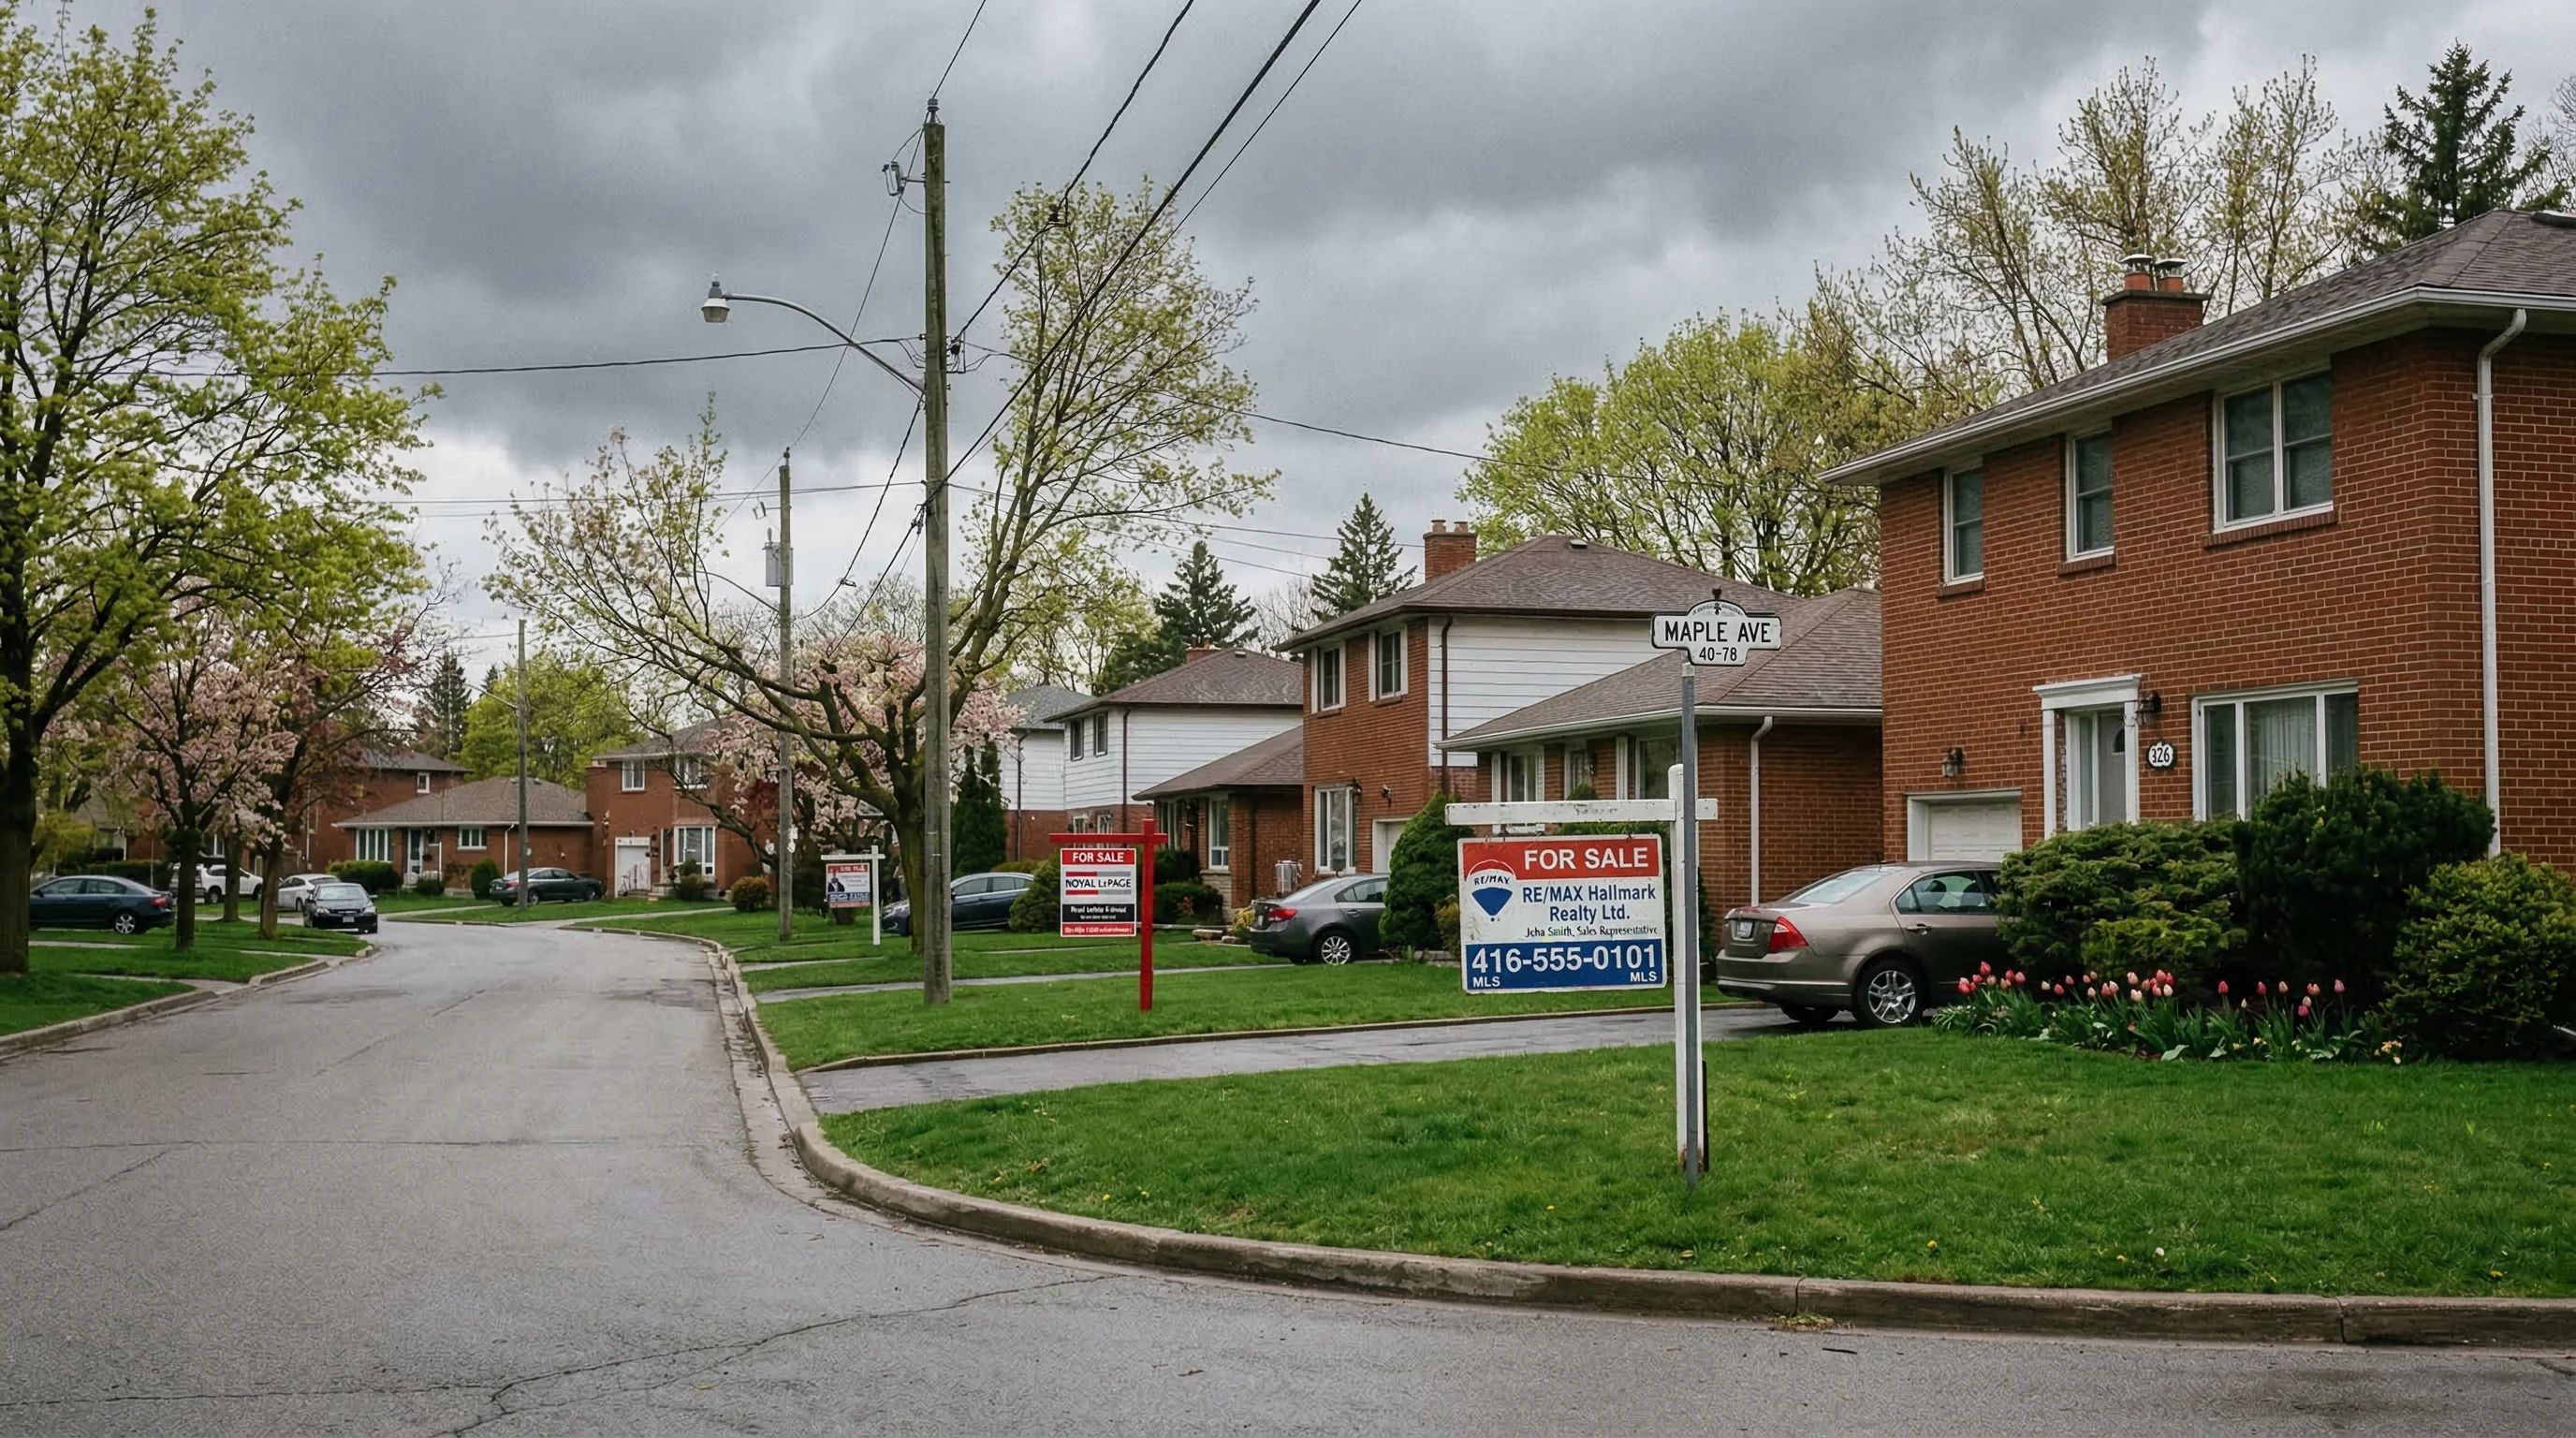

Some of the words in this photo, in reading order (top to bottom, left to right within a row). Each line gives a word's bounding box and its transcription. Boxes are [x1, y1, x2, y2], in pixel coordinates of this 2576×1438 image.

[1664, 621, 1728, 642] MAPLE
[1737, 622, 1772, 643] AVE
[1699, 647, 1737, 661] 40-78
[2152, 747, 2170, 763] 326
[1073, 852, 1094, 863] FOR
[1097, 852, 1125, 863] SALE
[1524, 849, 1576, 870] FOR
[1585, 847, 1648, 869] SALE
[1523, 886, 1584, 904] RE/MAX
[1588, 884, 1656, 901] Hallmark
[1550, 905, 1597, 924] Realty
[1603, 904, 1631, 920] Ltd.
[1471, 944, 1655, 973] 416-555-0101
[1472, 976, 1500, 988] MLS
[1630, 971, 1657, 983] MLS
